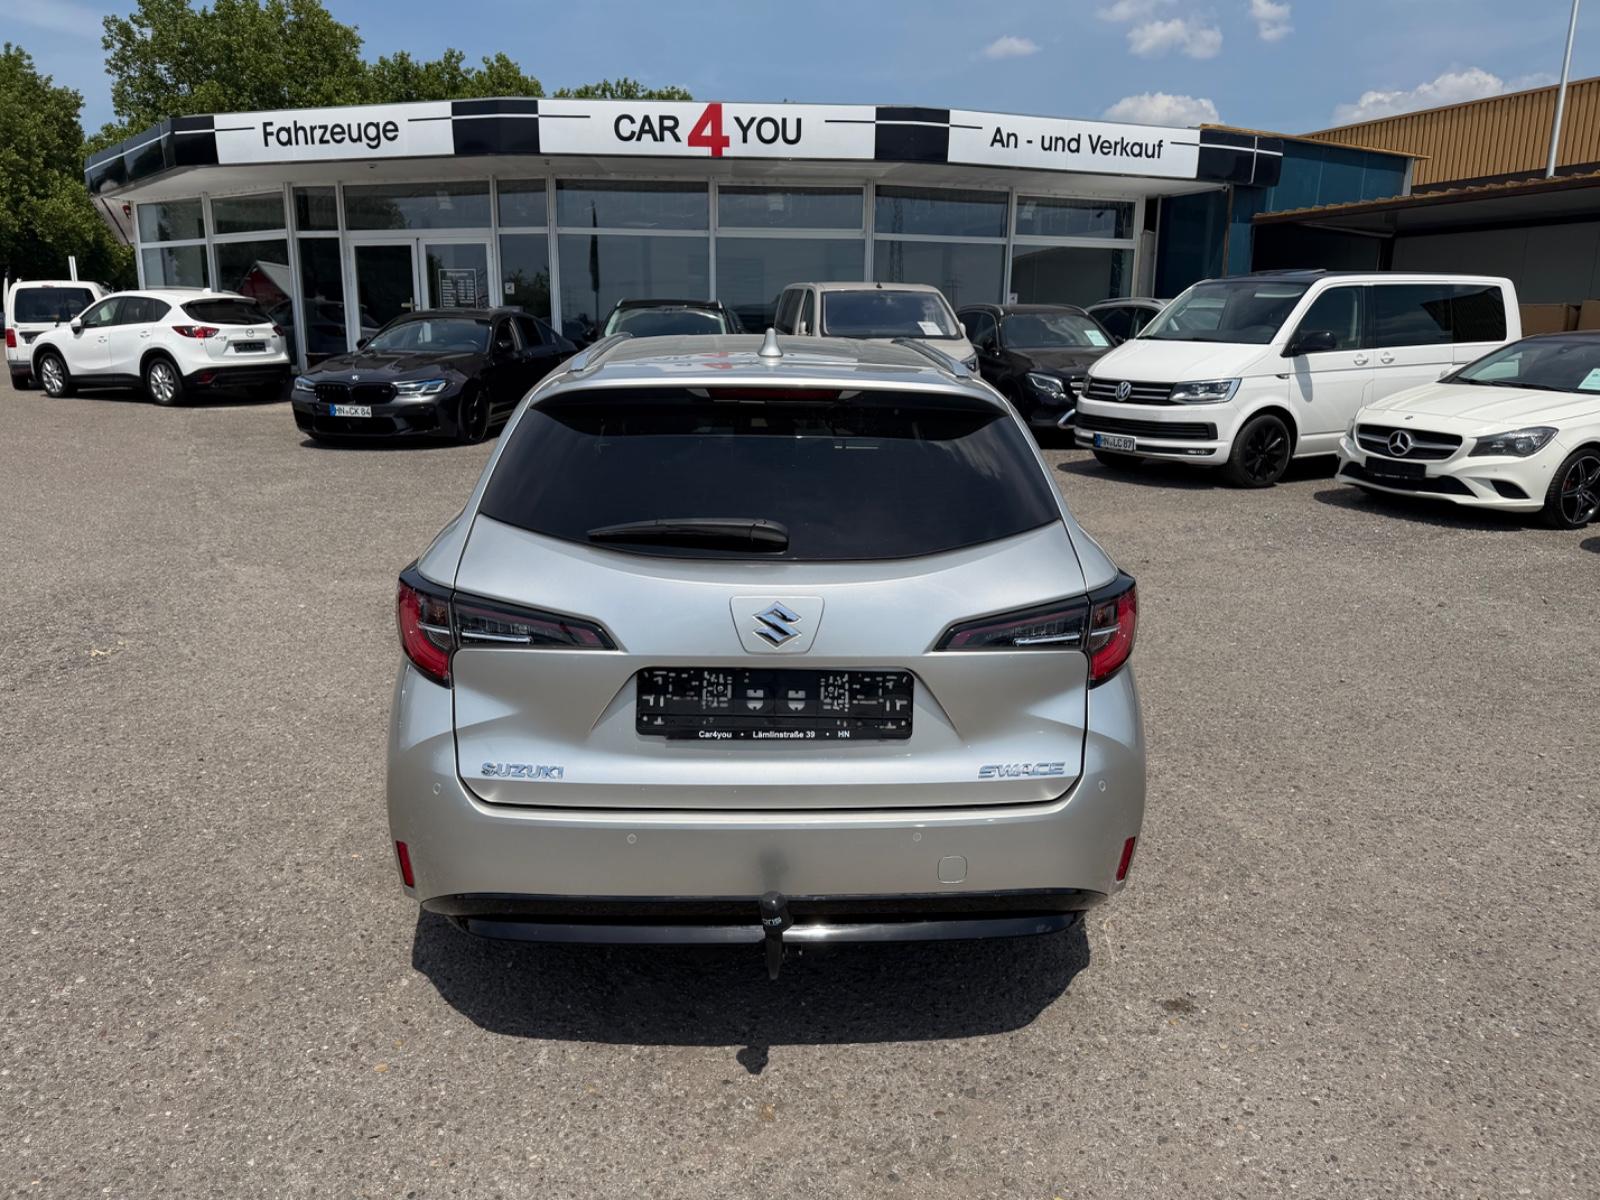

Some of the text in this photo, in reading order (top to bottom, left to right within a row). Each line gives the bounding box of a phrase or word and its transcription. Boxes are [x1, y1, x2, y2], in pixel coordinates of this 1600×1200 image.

[262, 120, 399, 150] Fahrzeuge
[1040, 133, 1081, 154] und
[1088, 134, 1164, 159] Verkauf
[698, 730, 733, 740] Car4you
[805, 730, 816, 738] 39
[837, 730, 850, 738] HN
[481, 761, 564, 779] SUZUKI
[977, 761, 1066, 779] SWACE
